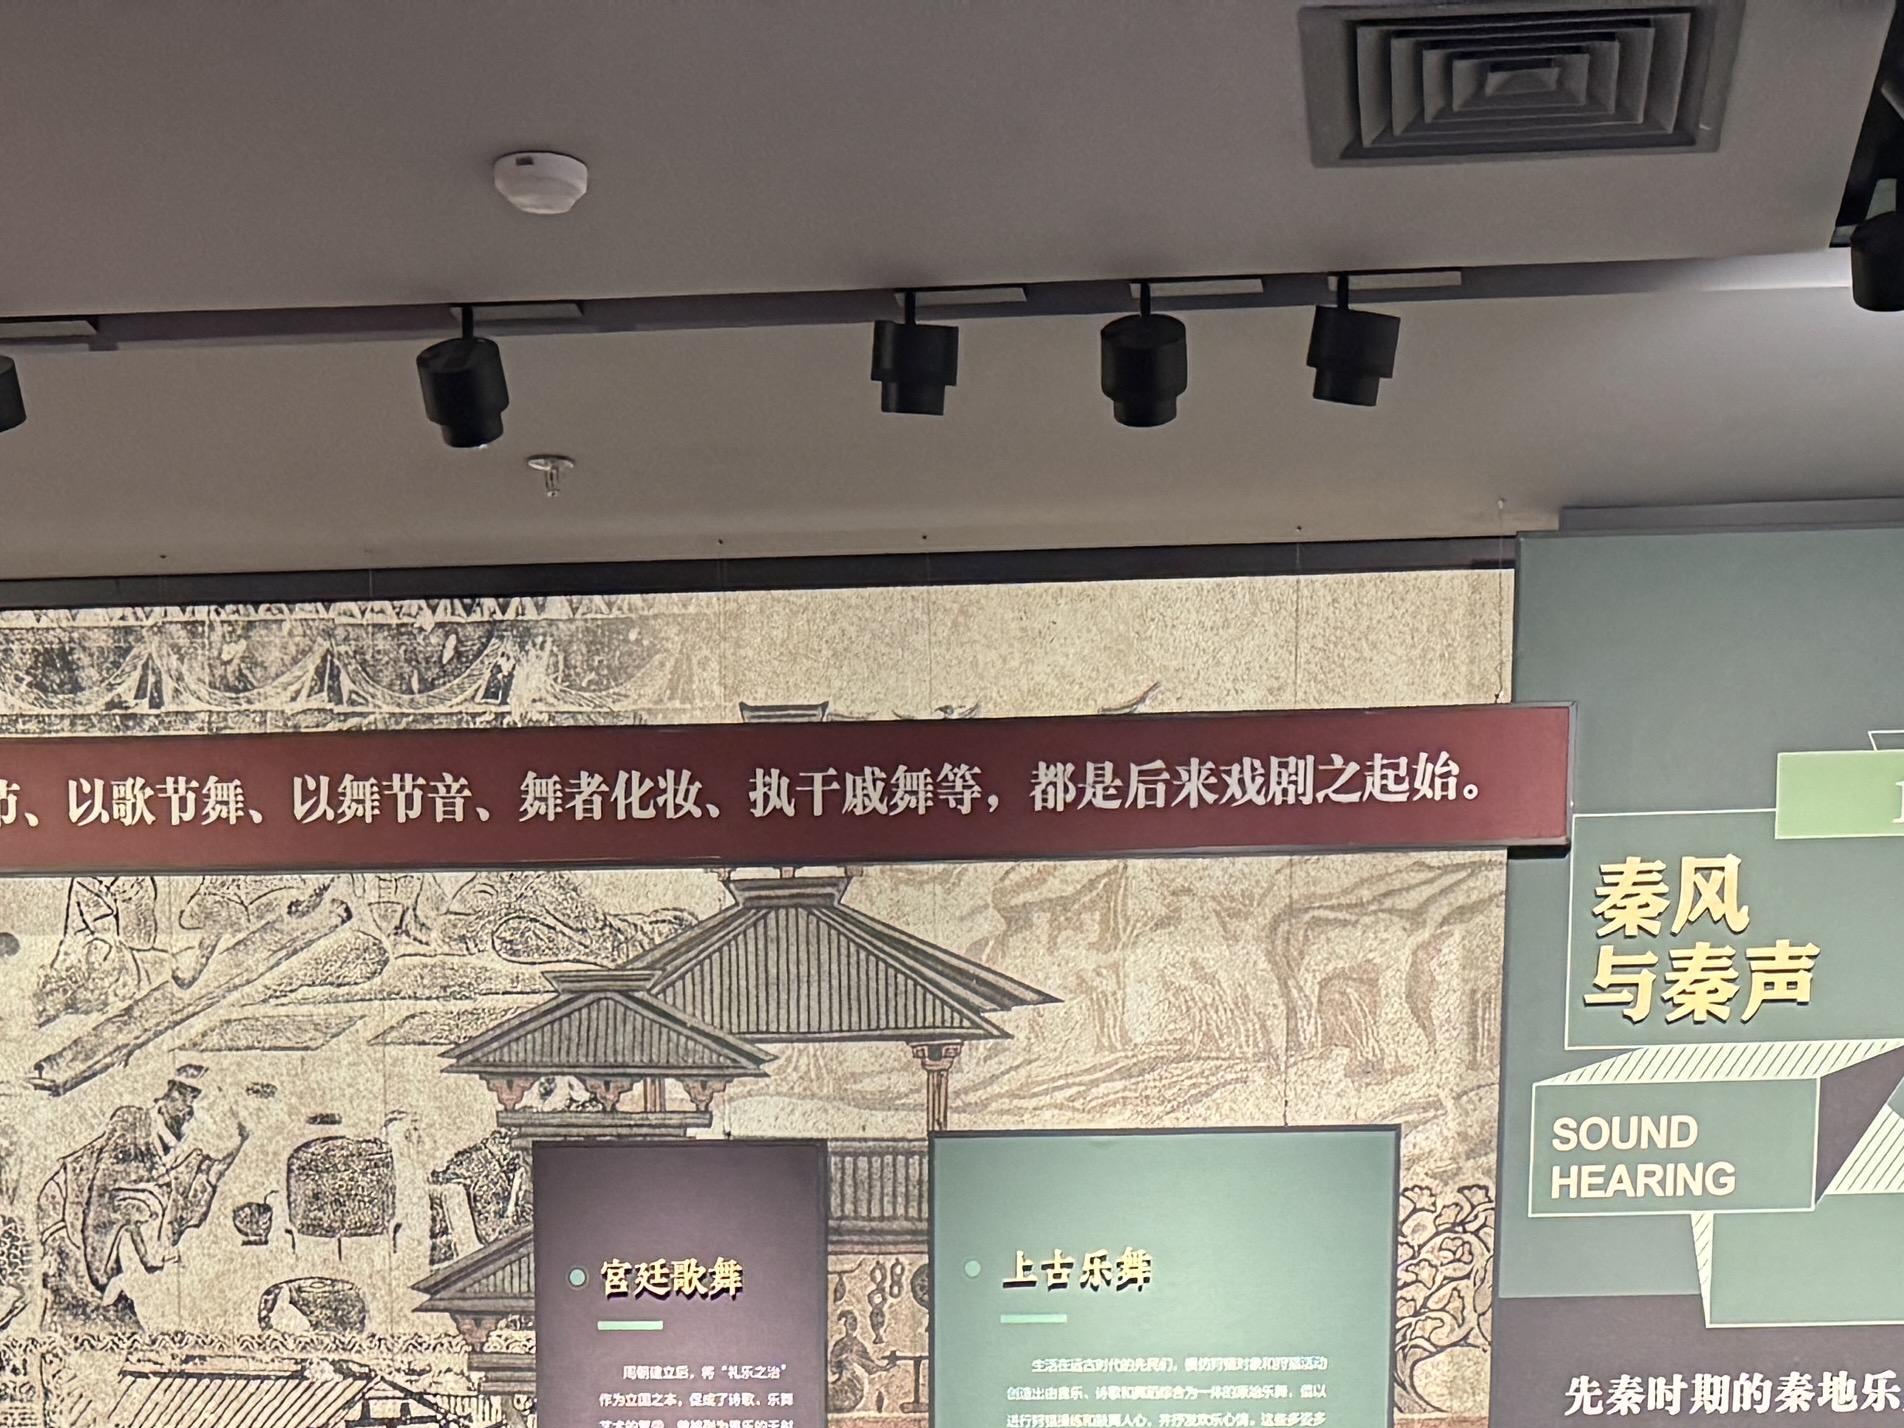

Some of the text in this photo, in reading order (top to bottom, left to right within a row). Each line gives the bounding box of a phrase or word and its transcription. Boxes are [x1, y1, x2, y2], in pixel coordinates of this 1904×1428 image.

[1593, 853, 1750, 938] 秦风
[1584, 938, 1820, 1024] 与秦声
[1551, 1114, 1698, 1152] SOUND
[1550, 1160, 1736, 1200] HEARING
[600, 1258, 744, 1299] 宫廷歌舞
[1002, 1247, 1154, 1292] 上古乐舞
